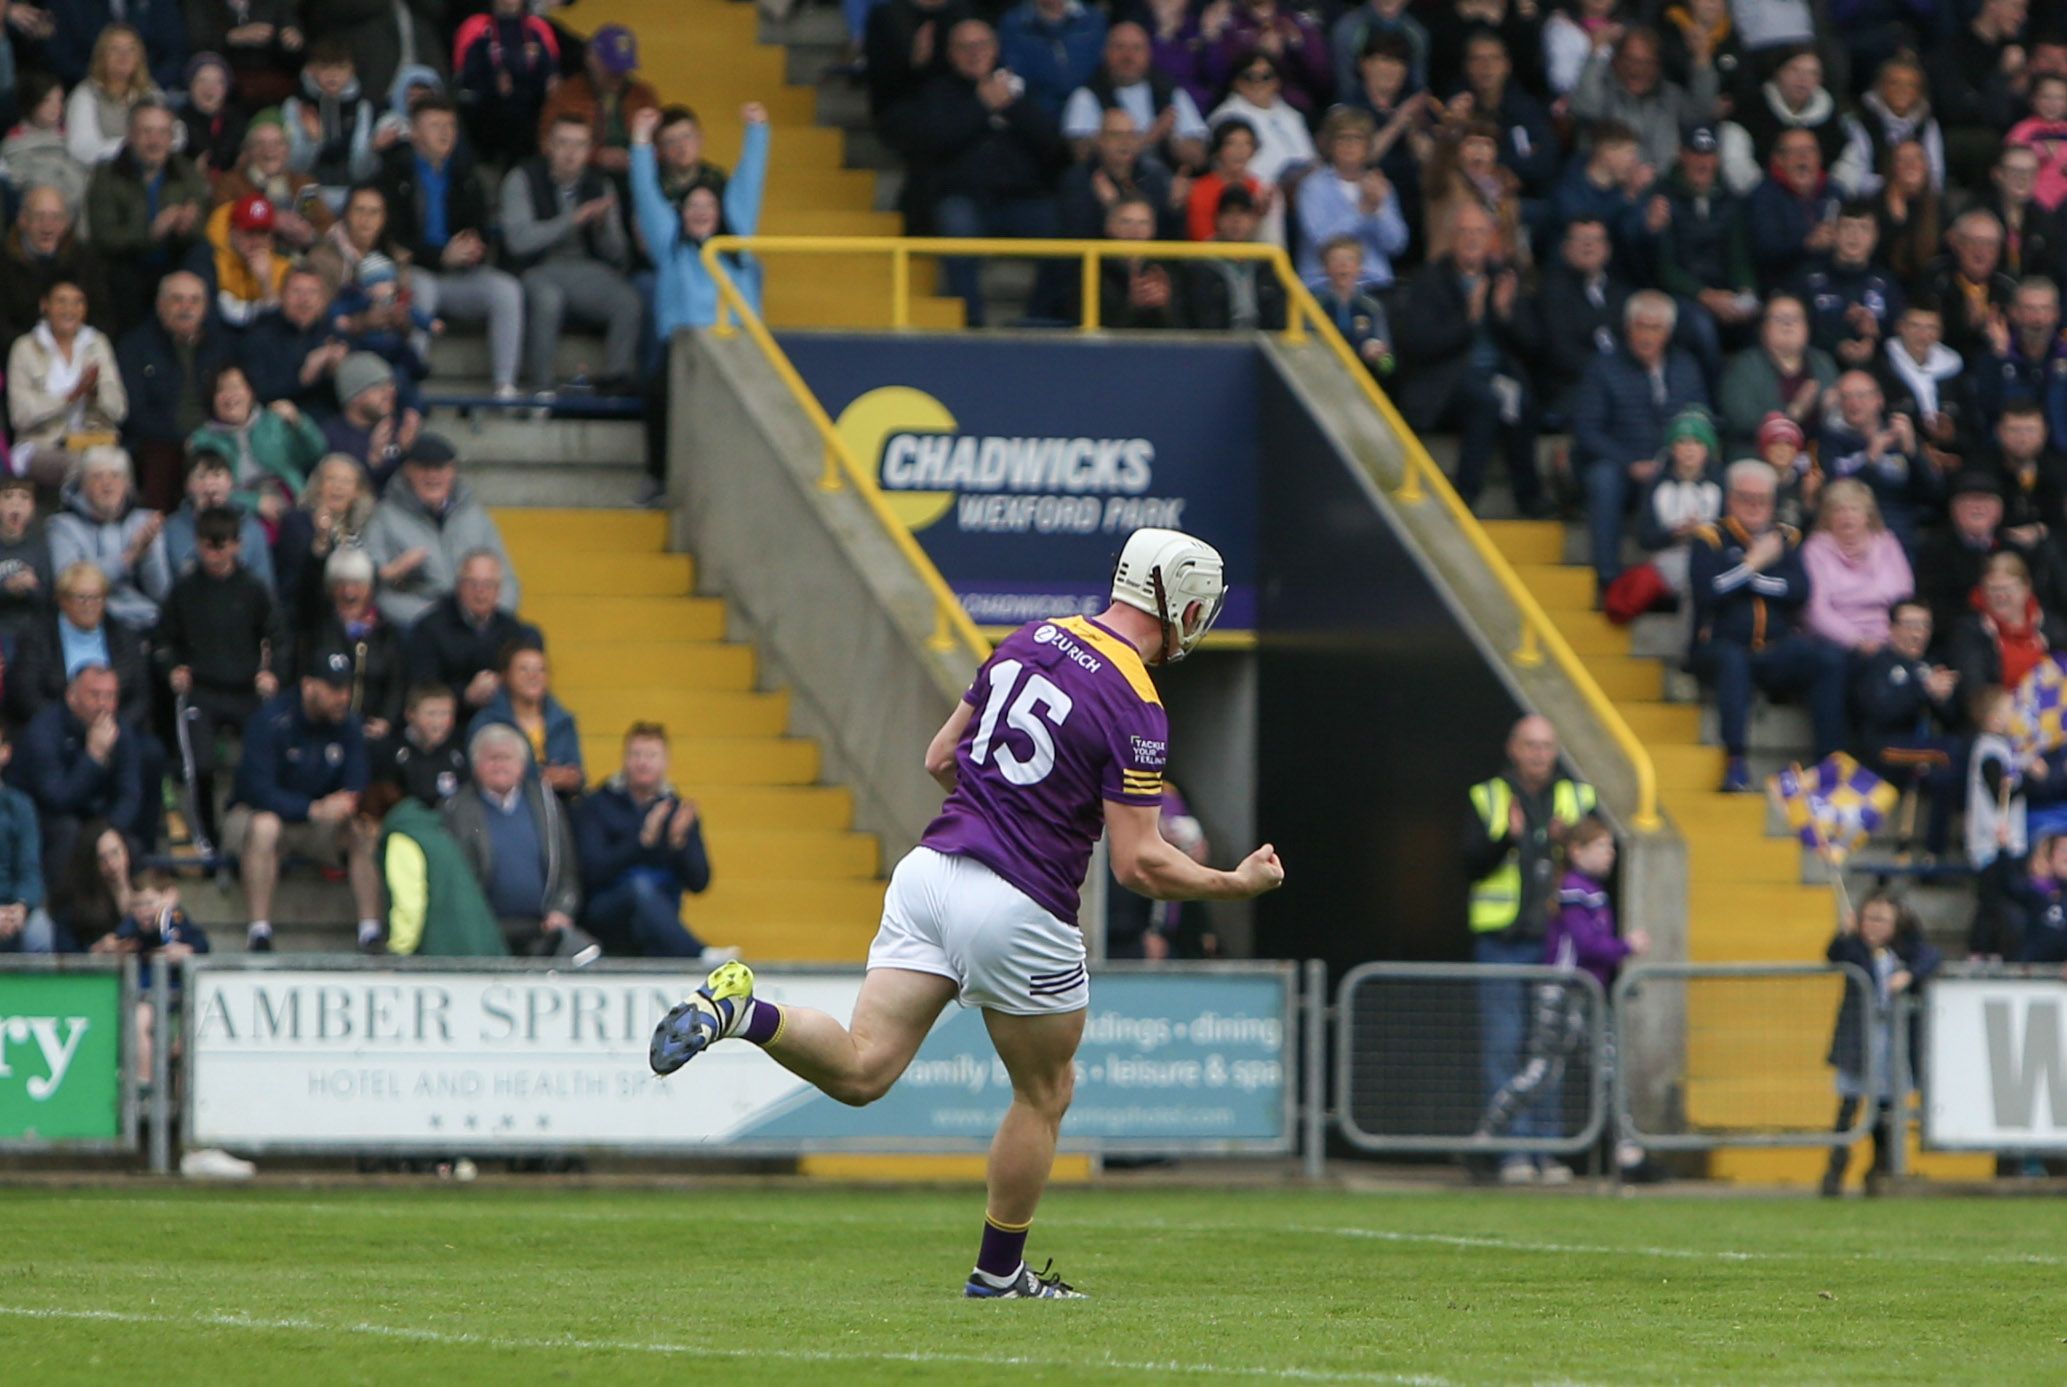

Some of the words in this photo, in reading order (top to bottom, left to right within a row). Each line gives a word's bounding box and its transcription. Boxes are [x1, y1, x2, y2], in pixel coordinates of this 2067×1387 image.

[883, 434, 1155, 492] CHADWICKS
[958, 495, 1100, 533] WEXFORD
[1101, 497, 1186, 532] PARK
[1051, 633, 1101, 673] ZURICH
[970, 658, 1073, 785] 15
[1133, 747, 1157, 756] YOUR
[197, 983, 454, 1041] AMBER
[1191, 1012, 1283, 1052] dining
[307, 1069, 400, 1098] HOTEL
[412, 1069, 483, 1098] AND
[494, 1069, 609, 1098] HEALTH
[615, 1070, 677, 1098] SPA
[901, 1053, 989, 1094] amily
[1106, 1053, 1201, 1088] leisure
[1205, 1053, 1229, 1088] &
[1231, 1059, 1283, 1094] spa
